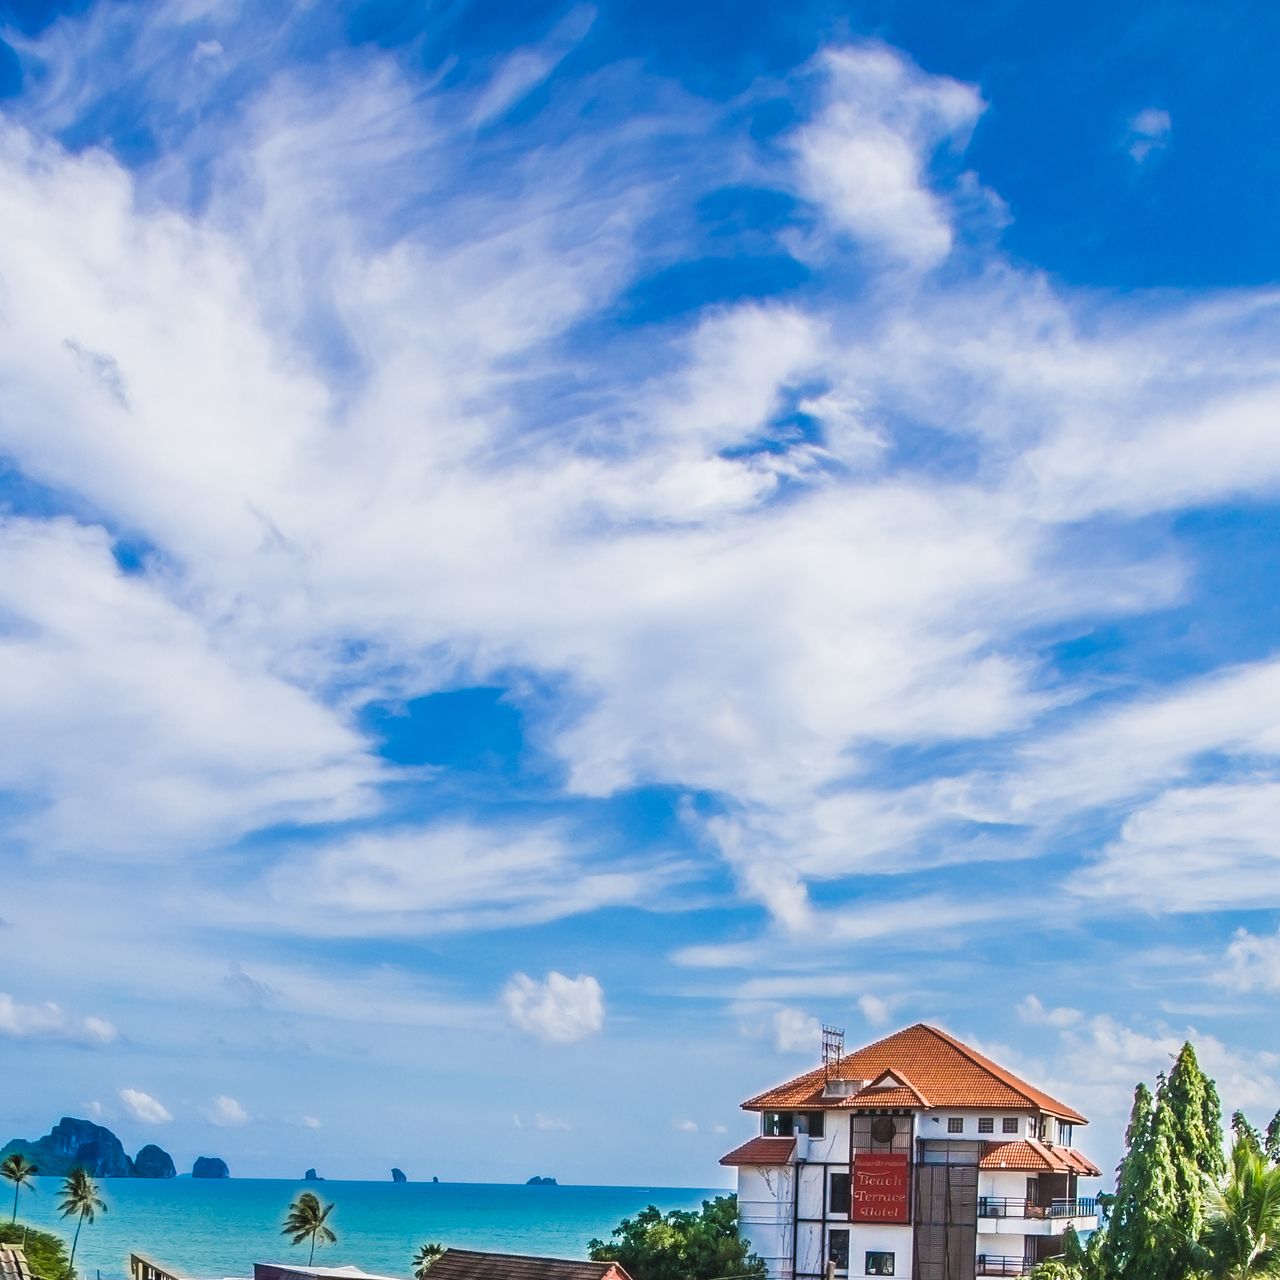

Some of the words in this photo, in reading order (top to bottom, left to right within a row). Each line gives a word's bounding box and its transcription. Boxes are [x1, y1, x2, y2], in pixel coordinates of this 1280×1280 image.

[857, 1171, 901, 1186] Beach
[854, 1191, 906, 1202] Terrace
[860, 1207, 899, 1217] Hotel
